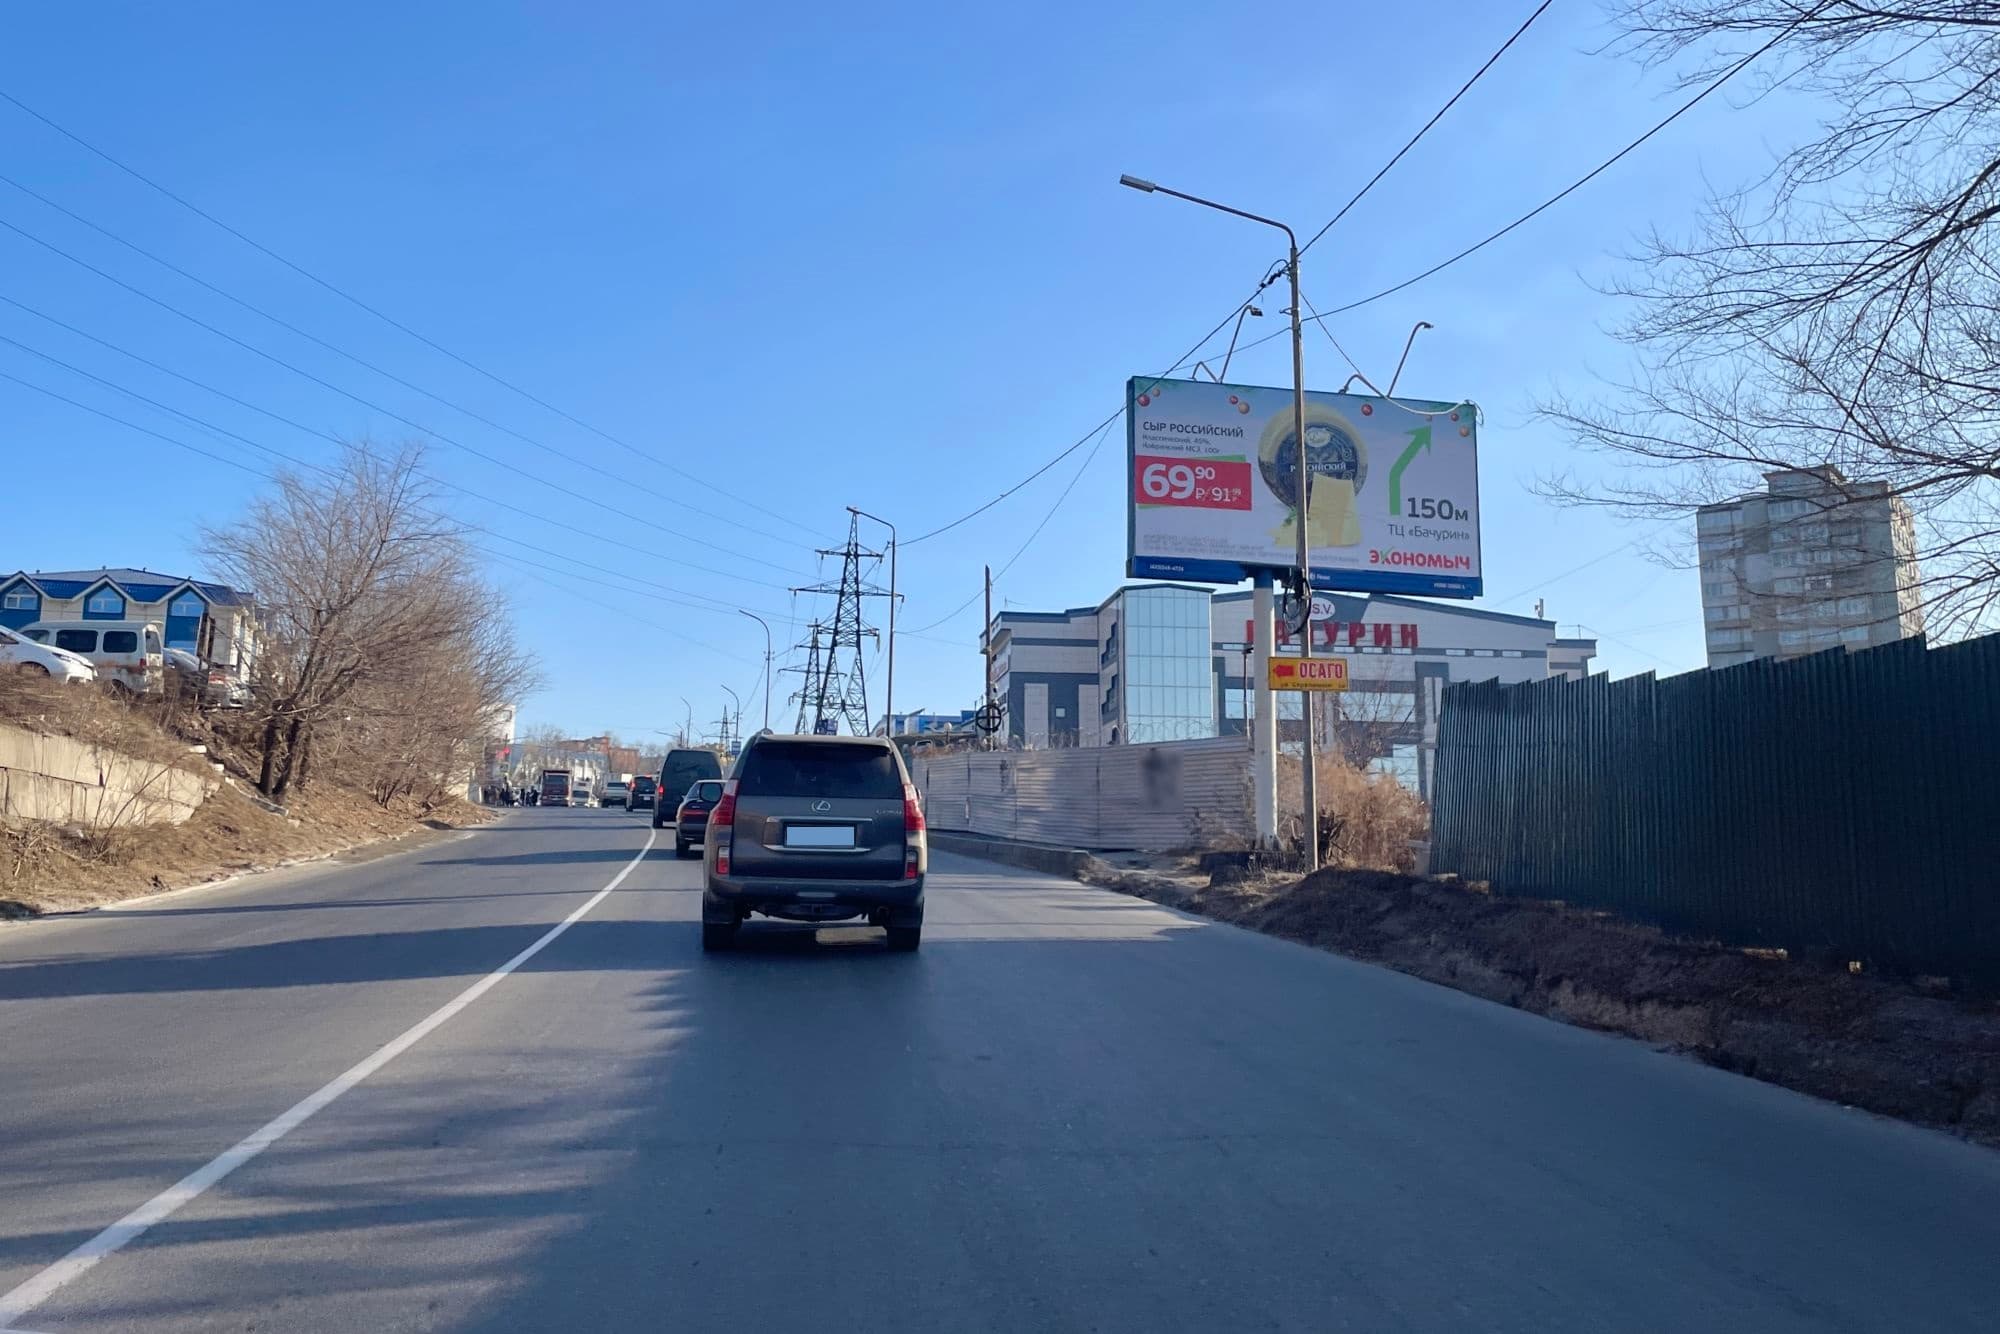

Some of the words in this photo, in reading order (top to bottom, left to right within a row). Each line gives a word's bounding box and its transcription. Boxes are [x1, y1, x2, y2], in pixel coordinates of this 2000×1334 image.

[1143, 421, 1167, 432] СЫР
[1169, 423, 1244, 438] РОССИЙСКИЙ
[1142, 463, 1196, 500] 69
[1195, 466, 1216, 480] 90
[1407, 497, 1468, 521] 150м
[1388, 524, 1405, 538] ТЦ
[1408, 526, 1470, 541] «Бачурин»
[1369, 548, 1471, 570] ЭКОНОМЫЧ
[1246, 619, 1418, 648] АУРИН
[1299, 662, 1343, 679] ОСАГО
